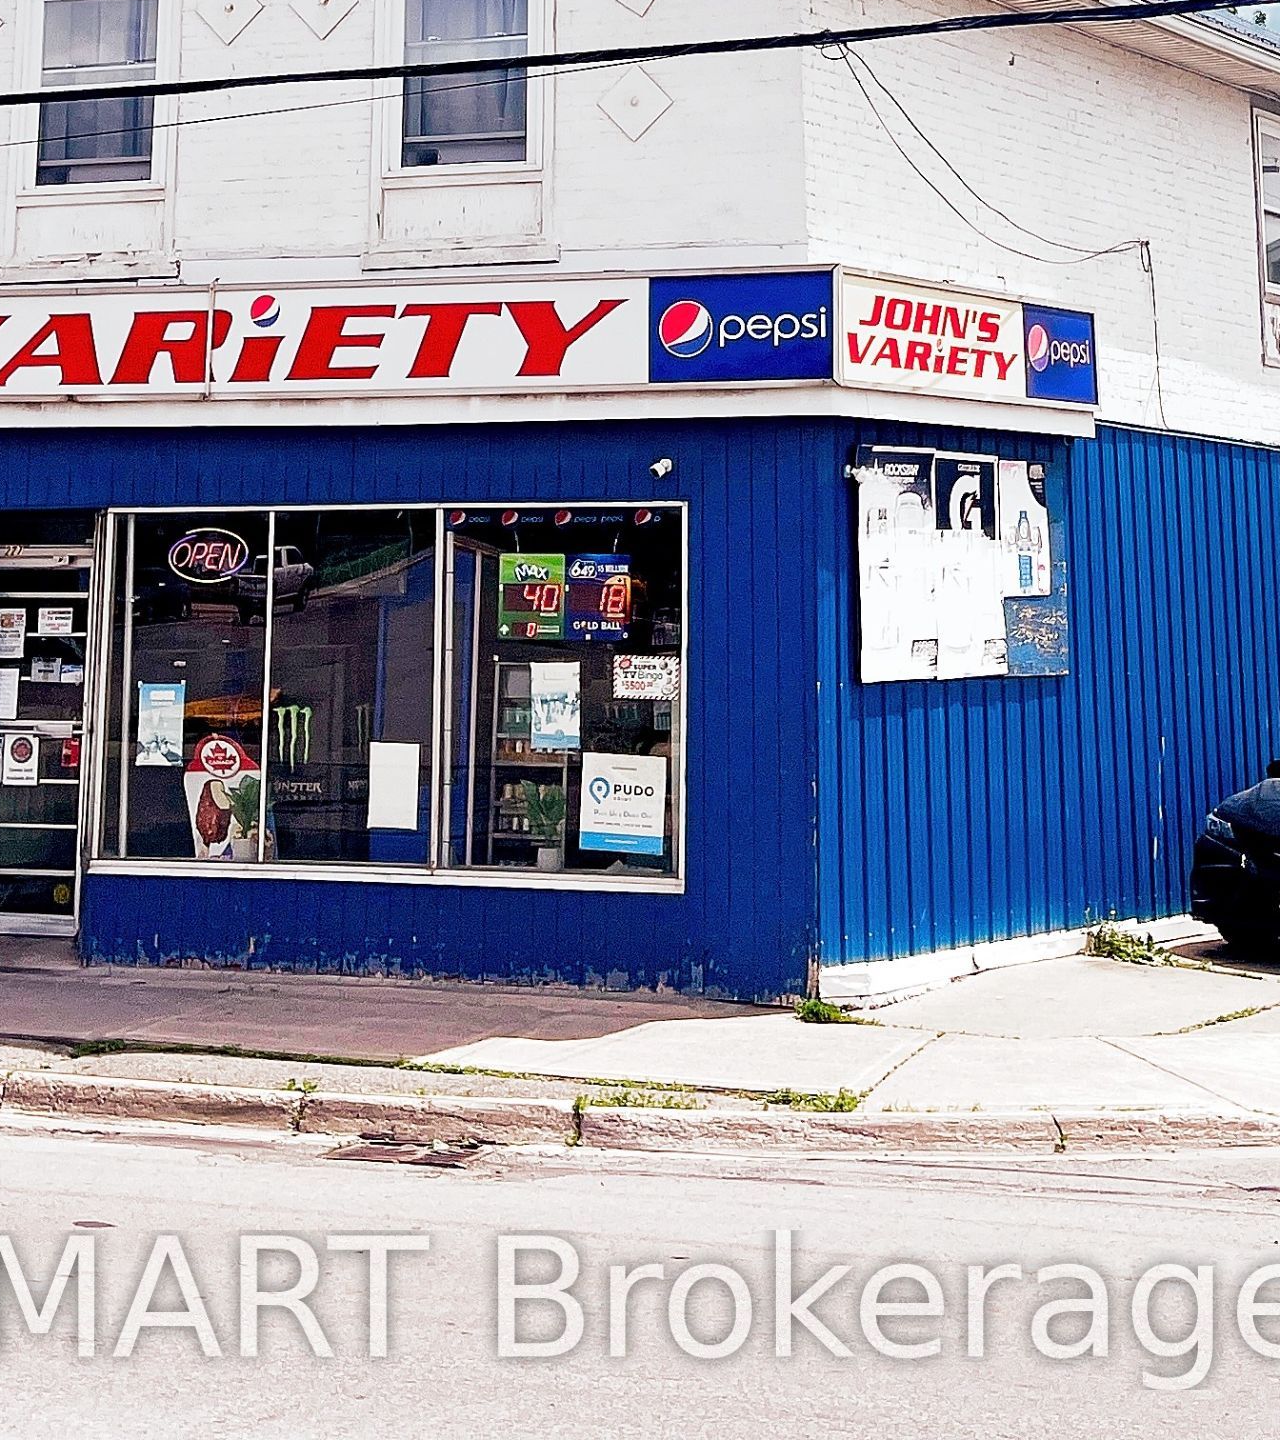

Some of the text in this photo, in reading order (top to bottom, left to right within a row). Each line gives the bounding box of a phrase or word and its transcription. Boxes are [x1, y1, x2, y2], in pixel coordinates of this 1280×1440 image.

[718, 305, 828, 350] pepsi
[859, 295, 1001, 343] JOHN'S
[1050, 336, 1091, 368] pepsi
[173, 543, 241, 570] OPEN
[570, 560, 595, 577] 649
[514, 563, 549, 581] MAX
[523, 584, 560, 611] 40
[599, 585, 627, 613] 18
[601, 621, 622, 630] BALL
[622, 670, 663, 682] TV Bingo
[613, 784, 655, 797] PUDO
